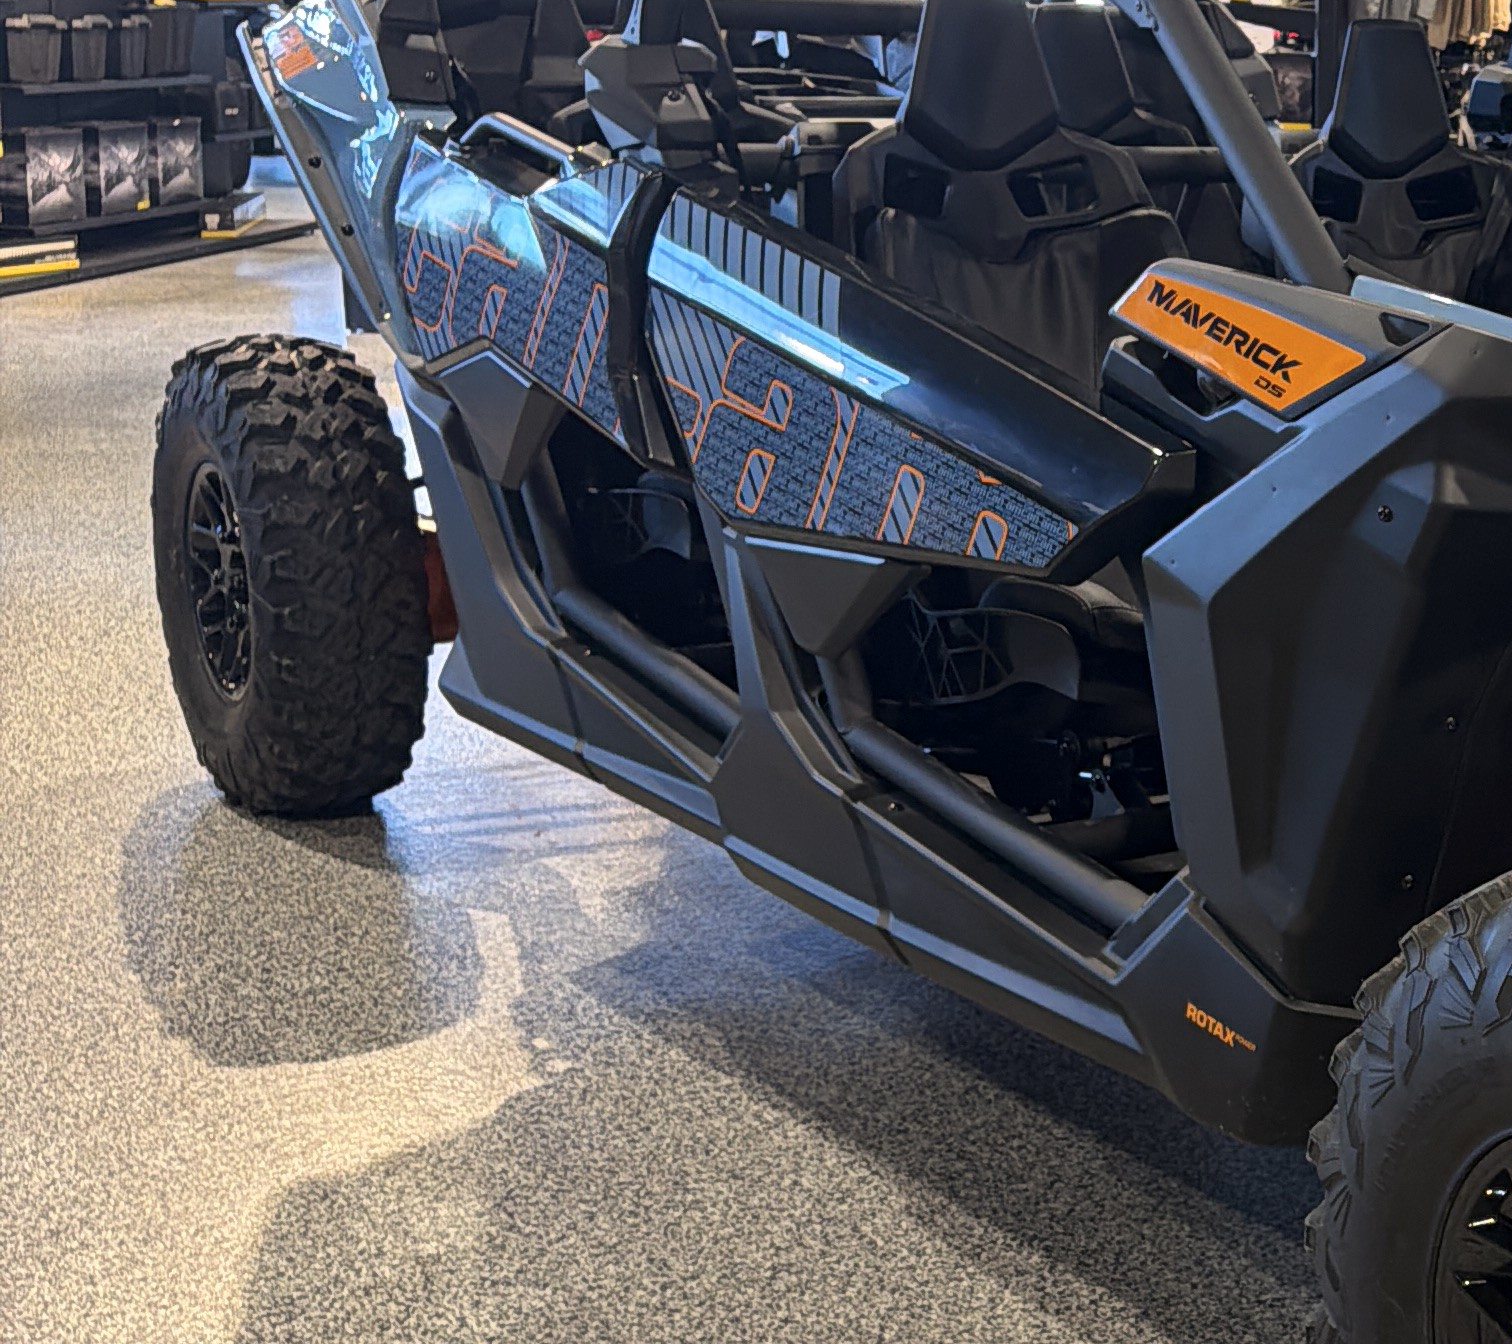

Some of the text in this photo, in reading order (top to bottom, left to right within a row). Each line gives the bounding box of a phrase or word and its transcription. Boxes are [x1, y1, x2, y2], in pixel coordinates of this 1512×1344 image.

[1147, 279, 1303, 385] MAVERICK
[1254, 375, 1287, 399] DS
[1186, 1002, 1236, 1048] ROTAX
